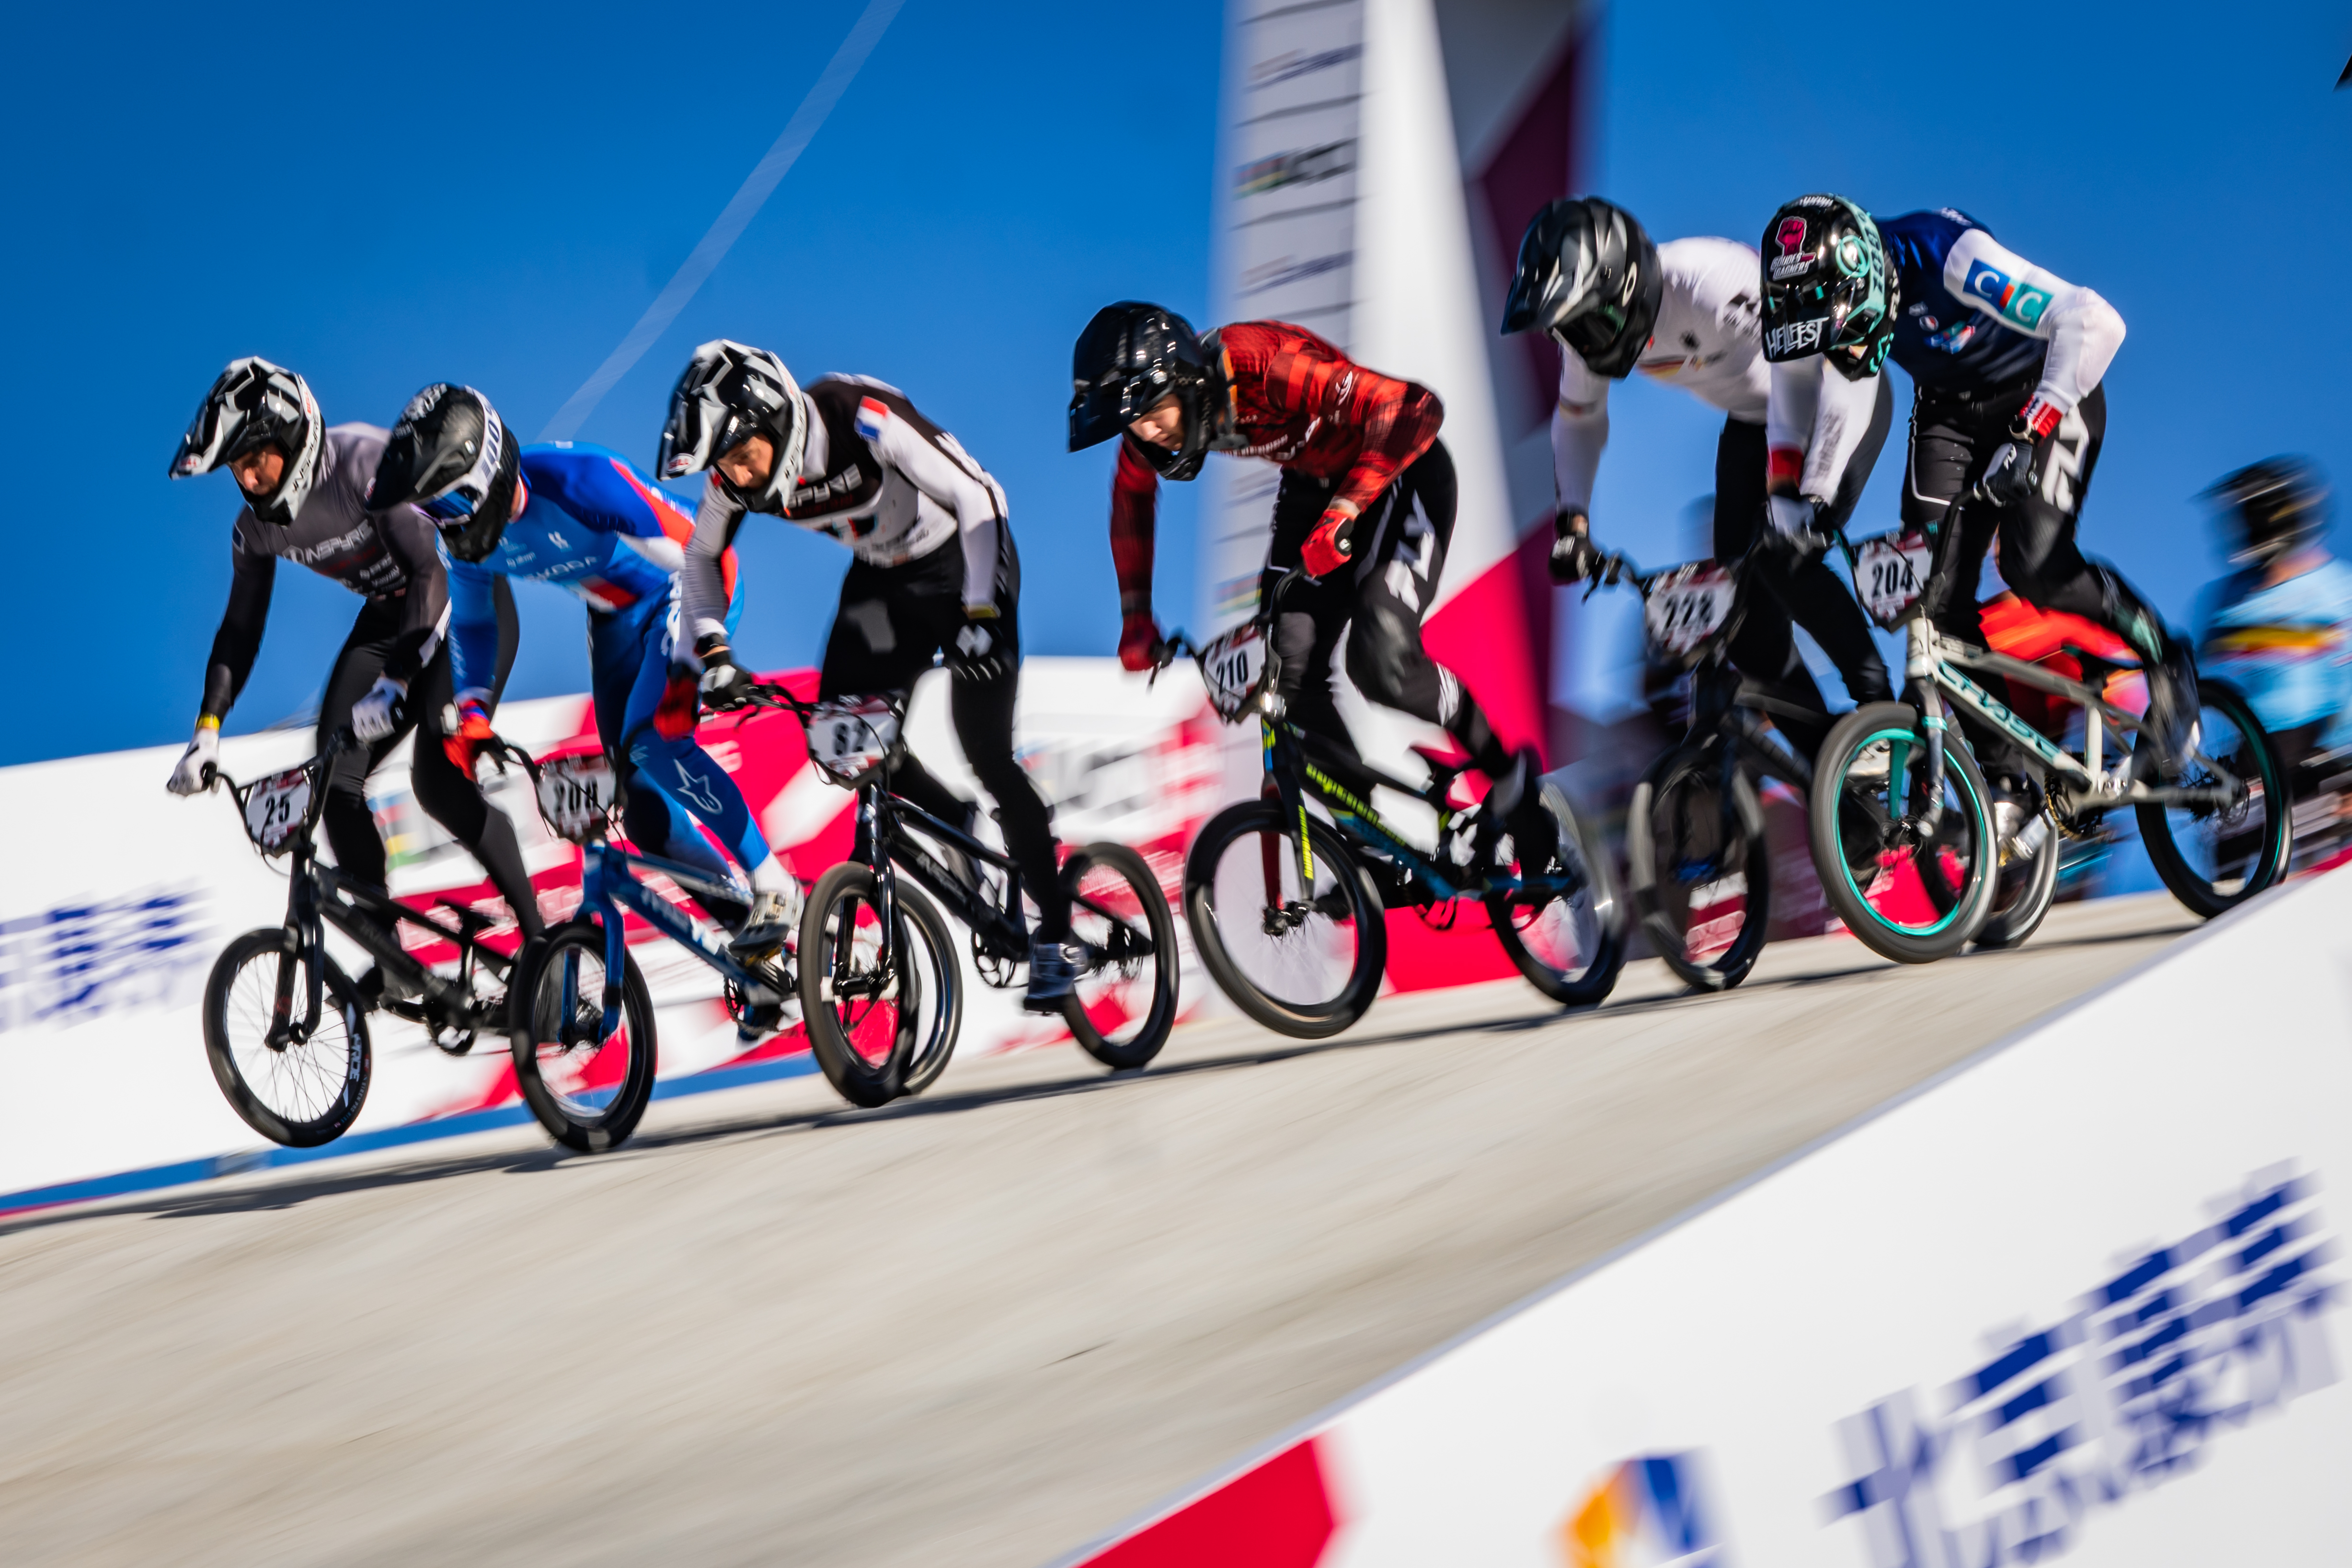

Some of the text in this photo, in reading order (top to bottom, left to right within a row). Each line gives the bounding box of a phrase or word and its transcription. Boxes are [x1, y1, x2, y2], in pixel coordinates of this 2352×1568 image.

[1974, 270, 2042, 322] CIC
[1765, 317, 1830, 360] HELLFEST
[1871, 557, 1914, 599] 204
[1216, 649, 1249, 695] 210
[265, 795, 290, 825] 25
